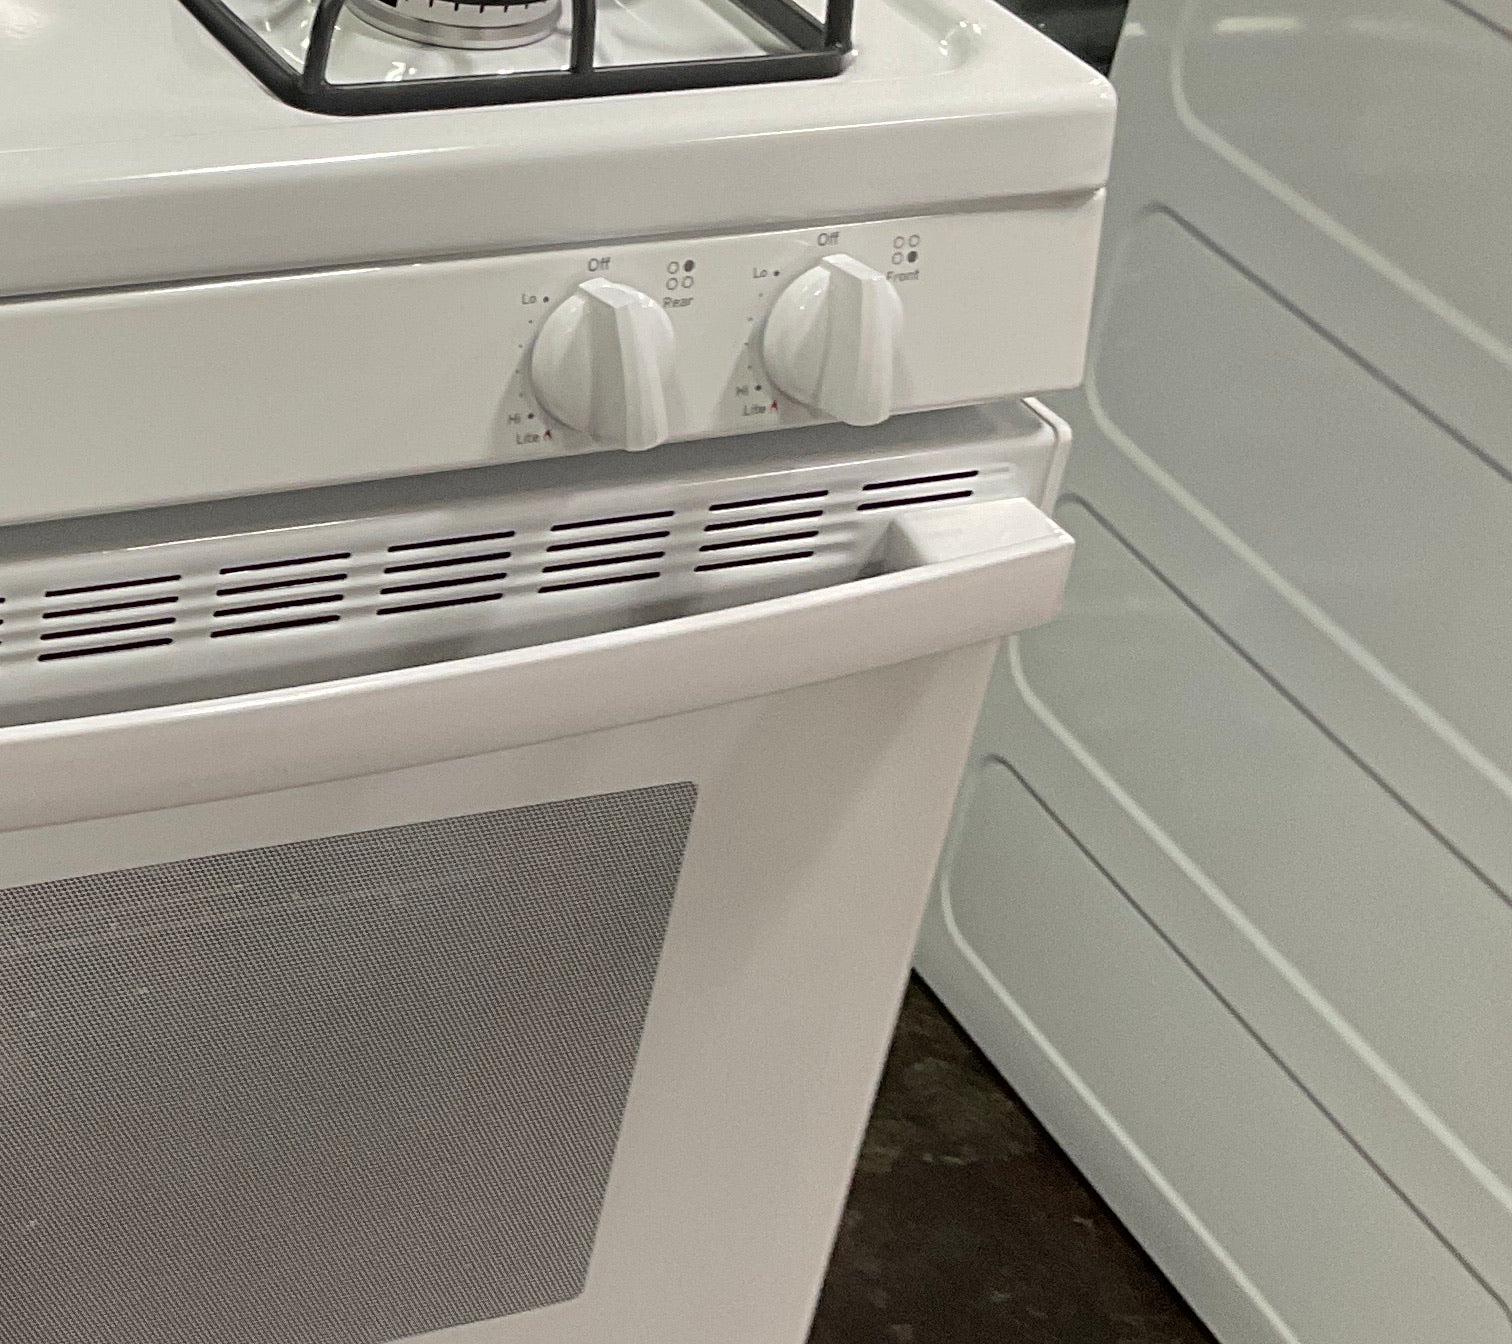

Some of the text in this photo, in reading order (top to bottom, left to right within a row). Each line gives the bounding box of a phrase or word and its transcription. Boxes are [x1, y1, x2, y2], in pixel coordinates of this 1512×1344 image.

[817, 232, 839, 246] Off
[588, 257, 611, 272] Off
[753, 268, 767, 278] Lo
[887, 270, 920, 281] Front
[522, 293, 537, 305] Lo
[663, 296, 694, 307] Rear
[516, 433, 539, 445] Lite
